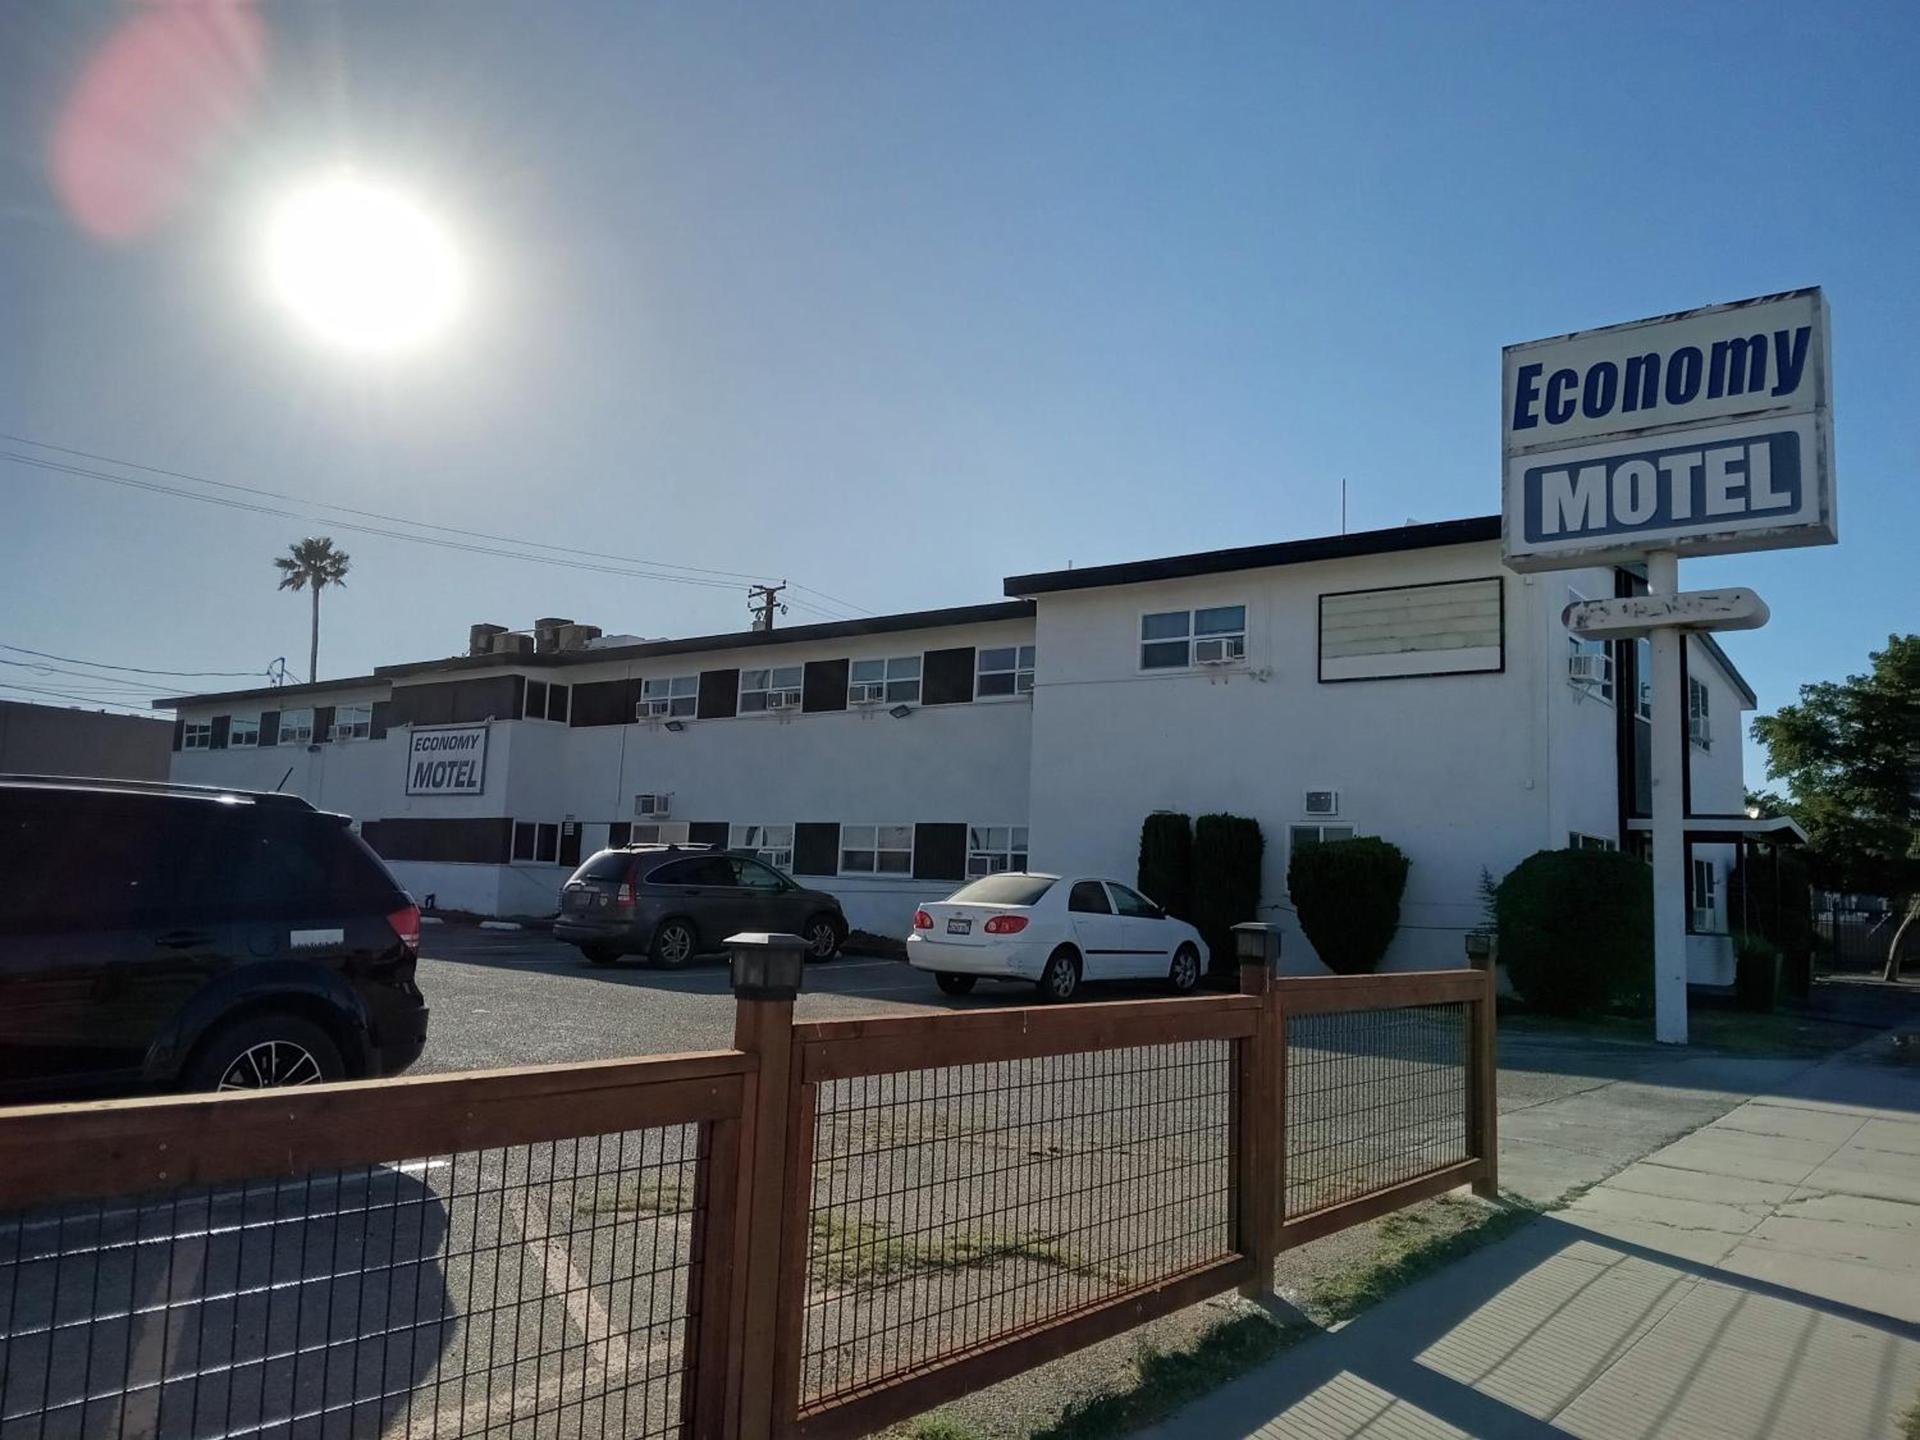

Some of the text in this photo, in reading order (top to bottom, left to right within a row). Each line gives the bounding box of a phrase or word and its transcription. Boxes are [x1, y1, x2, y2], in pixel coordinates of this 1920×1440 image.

[1512, 325, 1812, 431] Economy
[1541, 441, 1792, 535] MOTEL
[414, 734, 479, 752] ECONOMY
[413, 760, 477, 788] MOTEL
